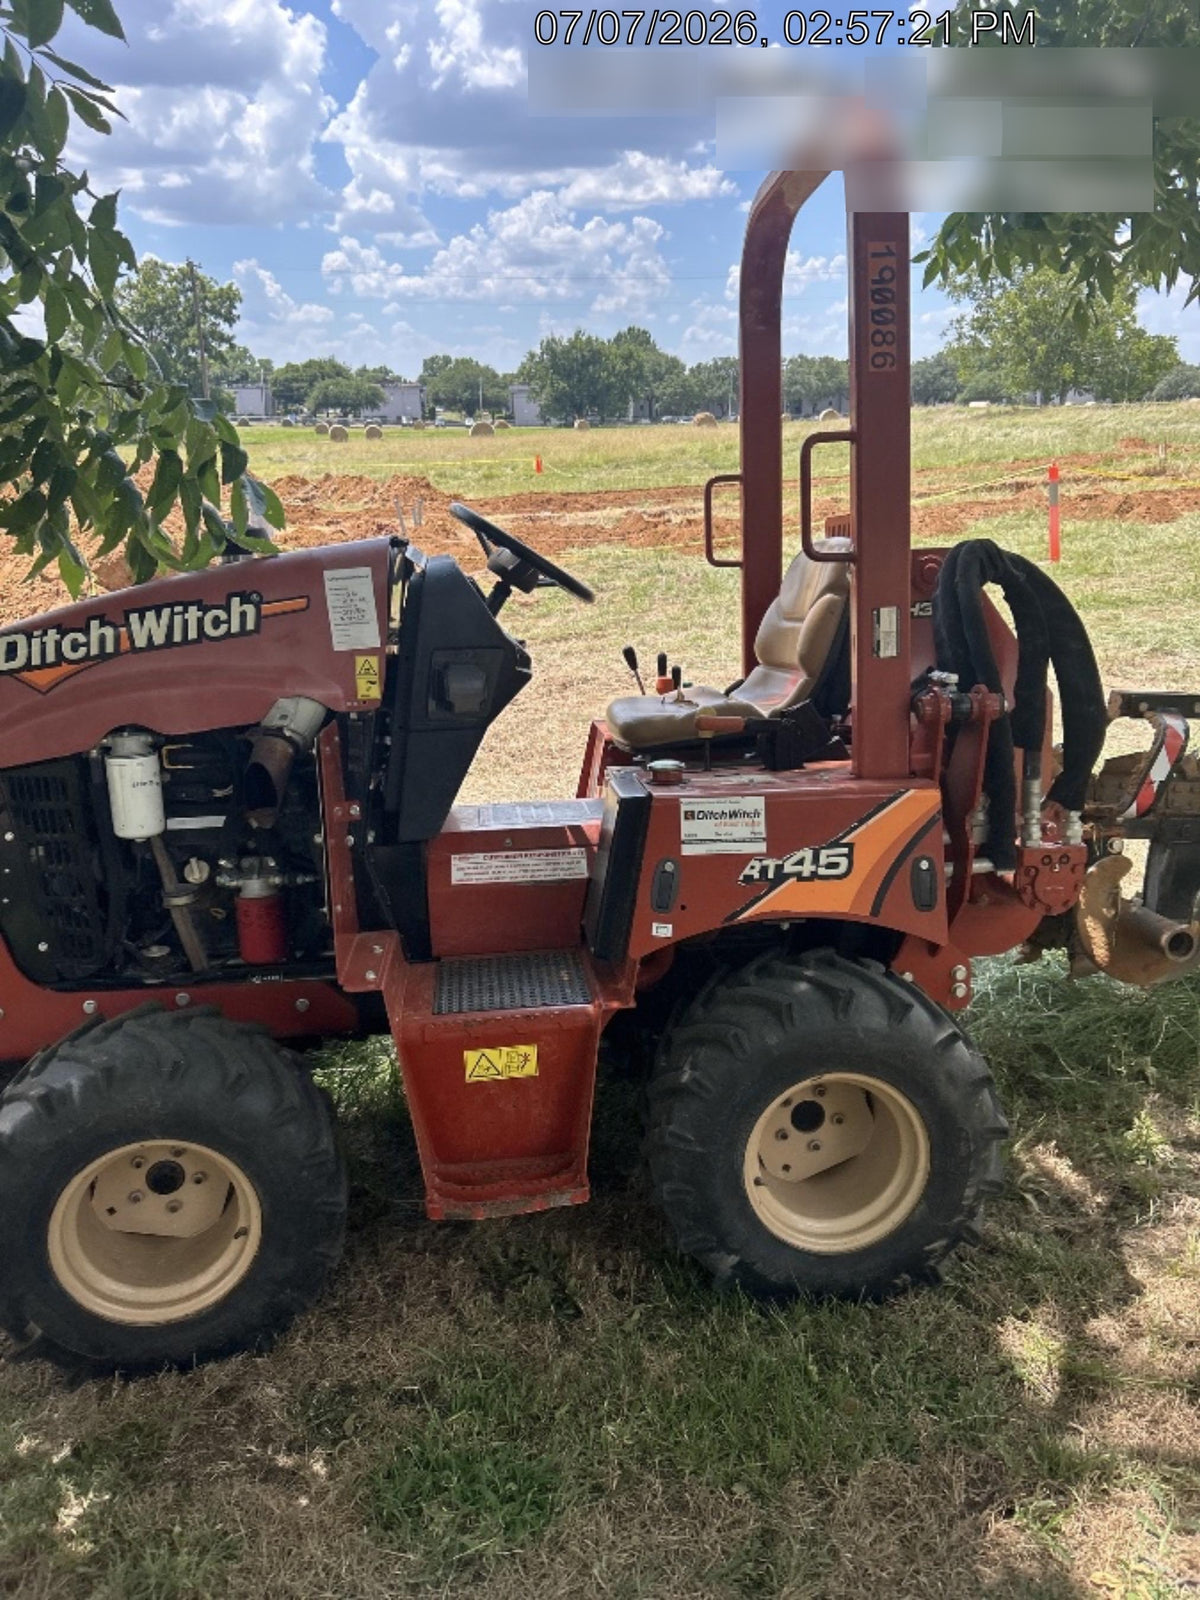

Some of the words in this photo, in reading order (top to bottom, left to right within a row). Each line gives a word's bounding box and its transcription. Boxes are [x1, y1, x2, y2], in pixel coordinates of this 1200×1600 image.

[870, 244, 896, 369] 190086
[0, 618, 116, 671] Ditch
[128, 596, 257, 649] Witch
[696, 809, 728, 820] Ditch
[728, 808, 761, 819] Witch
